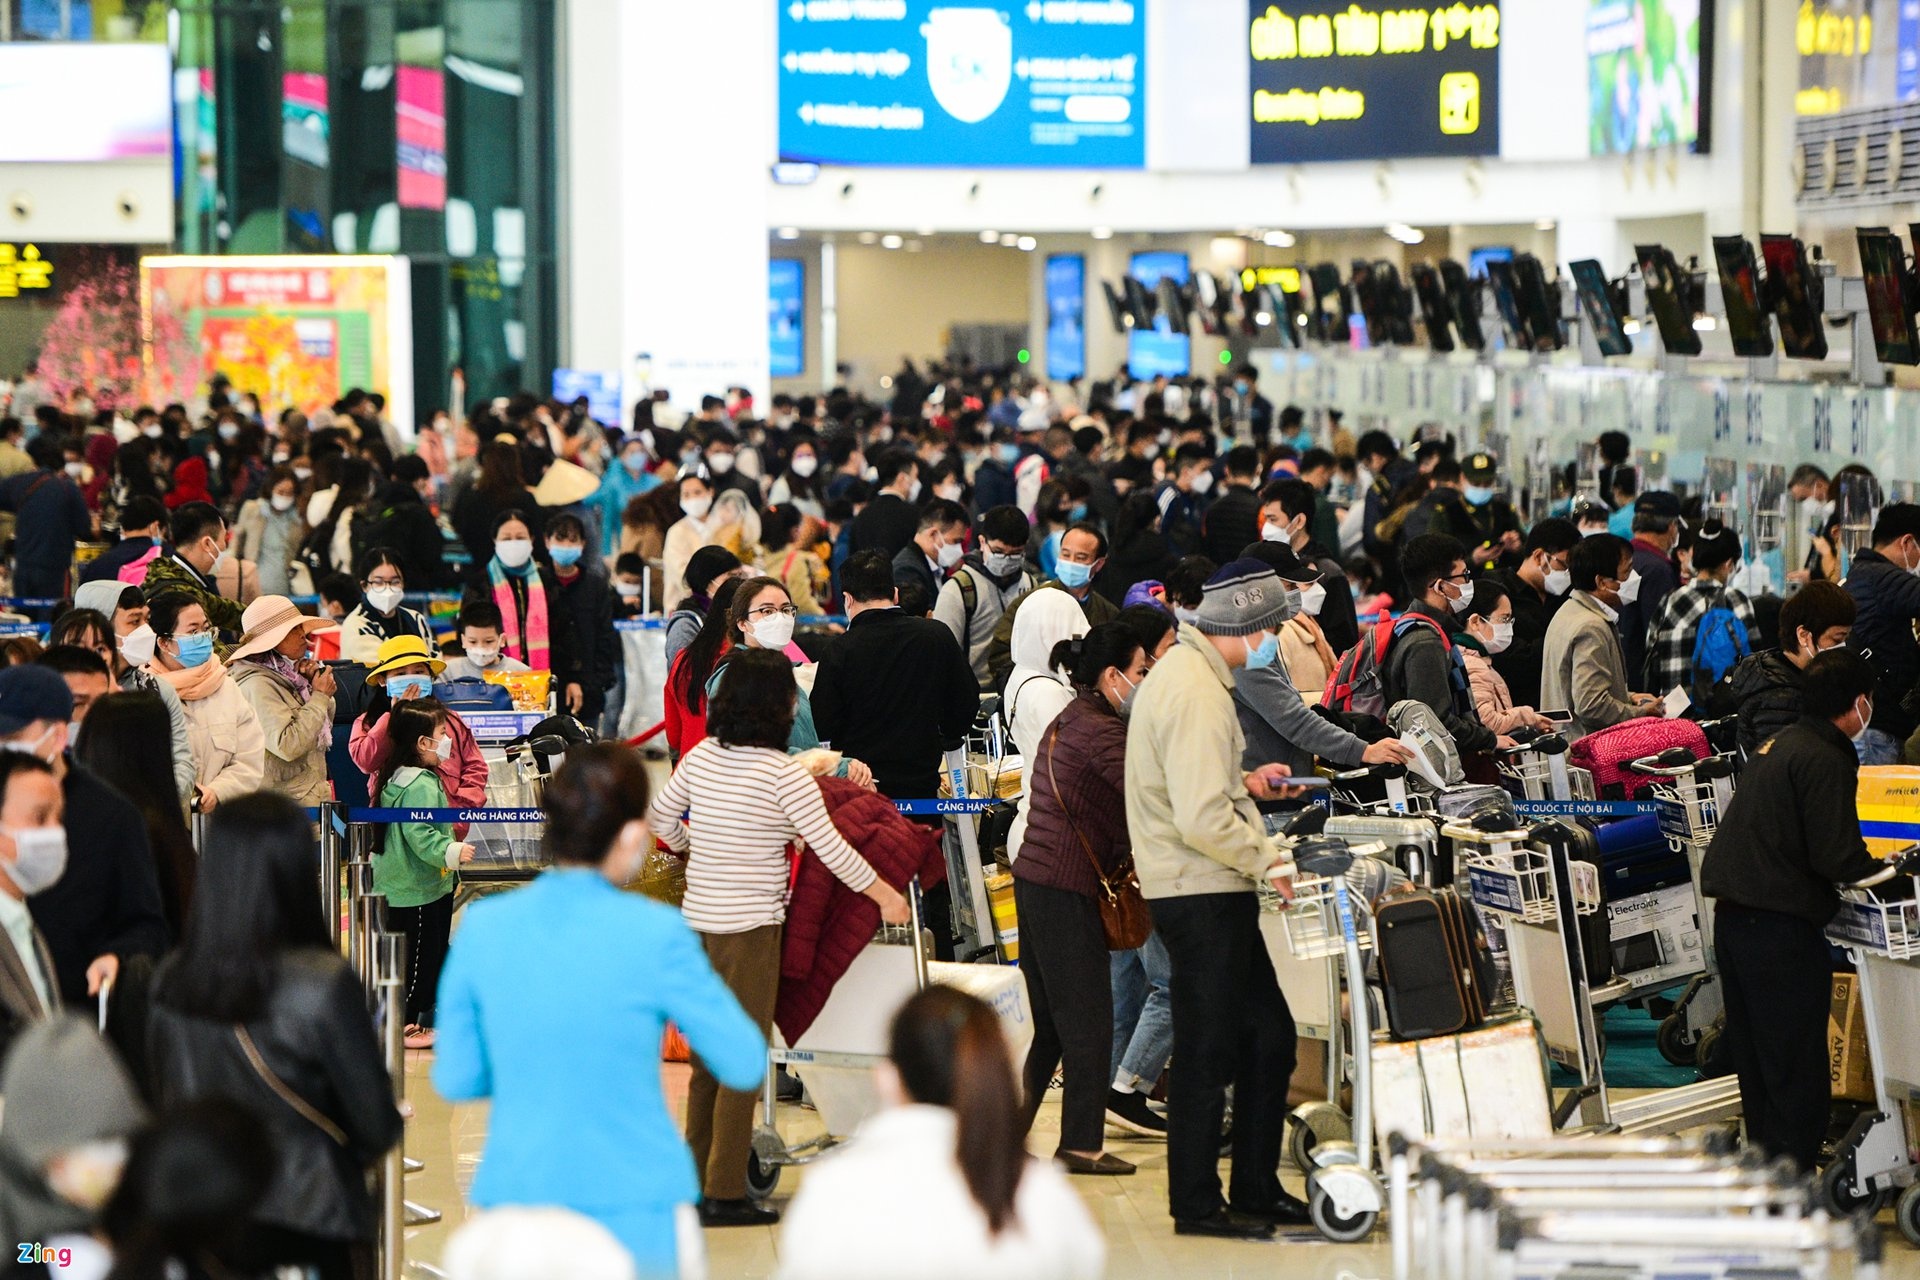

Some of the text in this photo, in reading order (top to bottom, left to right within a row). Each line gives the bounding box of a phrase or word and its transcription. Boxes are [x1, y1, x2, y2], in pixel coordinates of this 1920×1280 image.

[1814, 397, 1831, 452] B16
[1852, 397, 1869, 456] B17
[1233, 587, 1263, 608] 68
[410, 811, 433, 820] N.I.A
[459, 809, 487, 820] CẢNG
[519, 810, 548, 821] KHÔN
[896, 803, 912, 812] .I.A
[936, 800, 964, 812] CẢNG
[1532, 802, 1560, 813] QUỐC
[1562, 801, 1575, 813] TẾ
[1576, 803, 1594, 815] NỘI
[1614, 898, 1660, 915] Electrolux
[1831, 1036, 1844, 1081] APOLO
